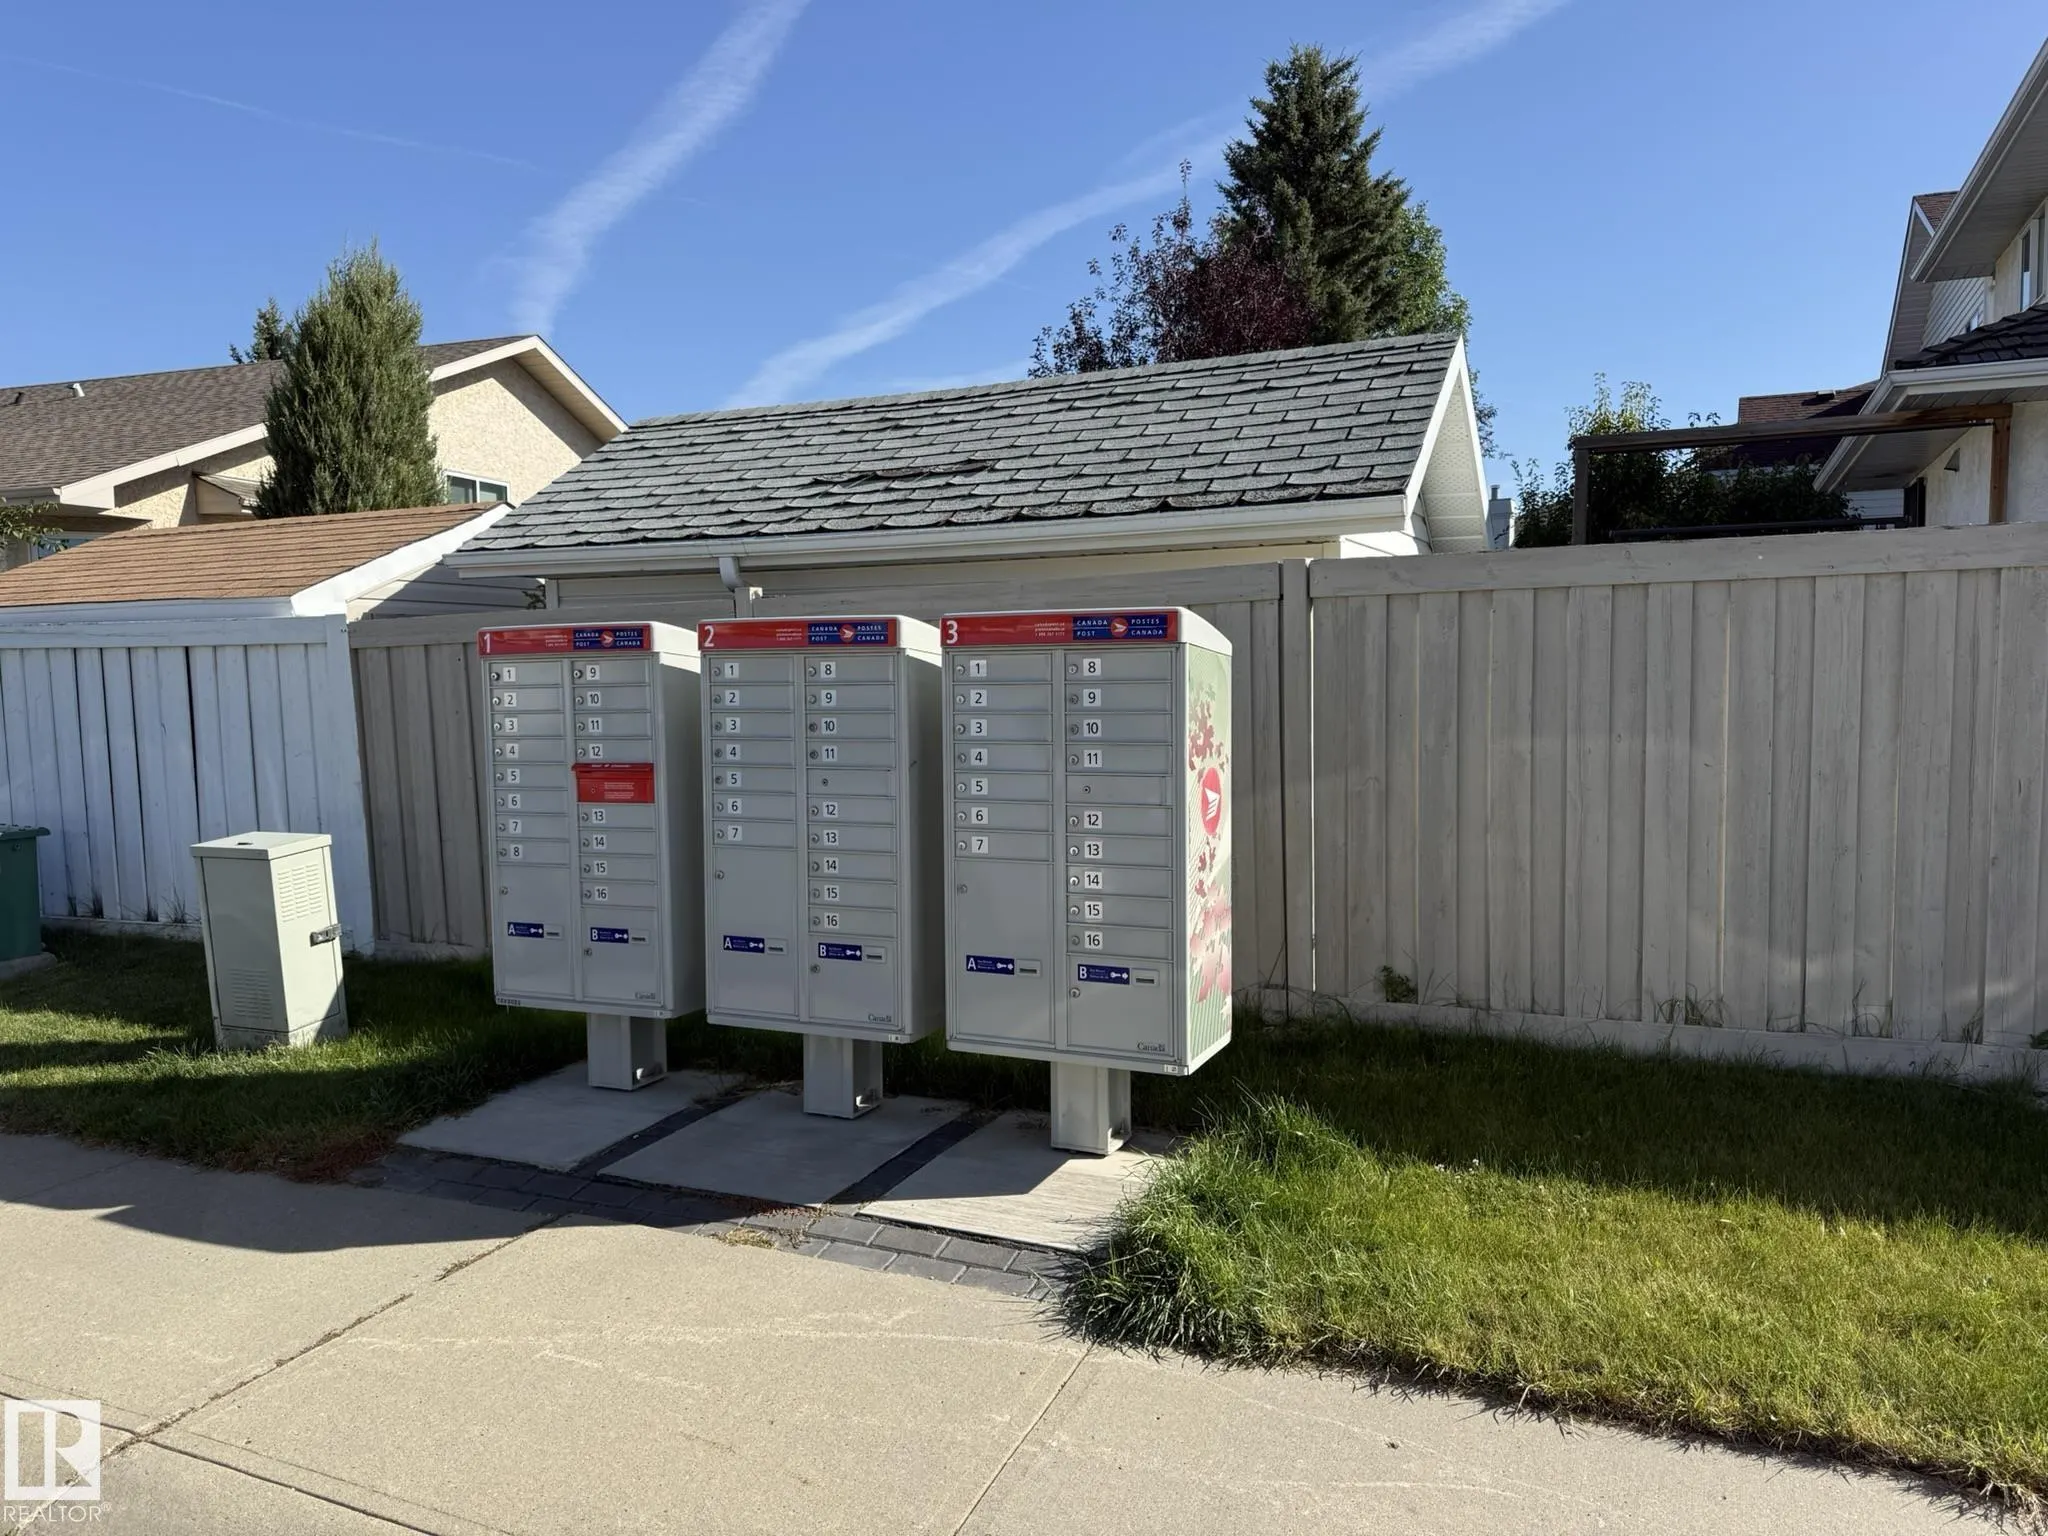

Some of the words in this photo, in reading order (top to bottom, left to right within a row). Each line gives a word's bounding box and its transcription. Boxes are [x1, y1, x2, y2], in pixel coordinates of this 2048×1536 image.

[704, 625, 715, 647] 2
[946, 620, 958, 644] 3
[484, 633, 491, 653] 1
[589, 666, 597, 679] 9
[728, 664, 735, 677] 1
[824, 663, 833, 676] 8
[974, 662, 981, 675] 1
[1087, 660, 1097, 674] 8
[505, 669, 513, 680] 1
[507, 694, 515, 706] 2
[589, 693, 600, 705] 10
[728, 691, 737, 704] 2
[825, 692, 833, 704] 9
[974, 691, 983, 705] 2
[1087, 691, 1097, 704] 9
[508, 719, 515, 731] 3
[590, 719, 600, 731] 11
[730, 719, 737, 731] 3
[823, 720, 836, 732] 10
[975, 721, 983, 734] 3
[1085, 721, 1099, 735] 10
[508, 745, 516, 756] 4
[591, 745, 602, 757] 12
[729, 746, 737, 758] 4
[824, 747, 835, 760] 11
[974, 751, 983, 763] 4
[1087, 752, 1098, 765] 11
[510, 770, 517, 782] 5
[730, 773, 738, 785] 5
[975, 780, 983, 793] 5
[511, 795, 518, 807] 6
[731, 800, 739, 812] 6
[593, 810, 605, 822] 13
[825, 804, 836, 816] 12
[975, 809, 984, 822] 6
[511, 820, 519, 832] 7
[1086, 813, 1099, 827] 12
[731, 827, 739, 839] 7
[825, 831, 837, 844] 13
[594, 836, 605, 848] 14
[976, 838, 984, 851] 7
[513, 846, 520, 857] 8
[1086, 843, 1100, 857] 13
[595, 862, 606, 874] 15
[825, 859, 837, 871] 14
[1086, 873, 1100, 887] 14
[595, 888, 607, 900] 16
[826, 887, 838, 899] 15
[1087, 903, 1100, 917] 15
[826, 914, 838, 927] 16
[508, 923, 516, 935] A
[591, 929, 599, 940] B
[724, 937, 733, 949] A
[1086, 933, 1101, 947] 16
[819, 944, 827, 957] B
[967, 957, 977, 970] A
[1079, 965, 1087, 979] B
